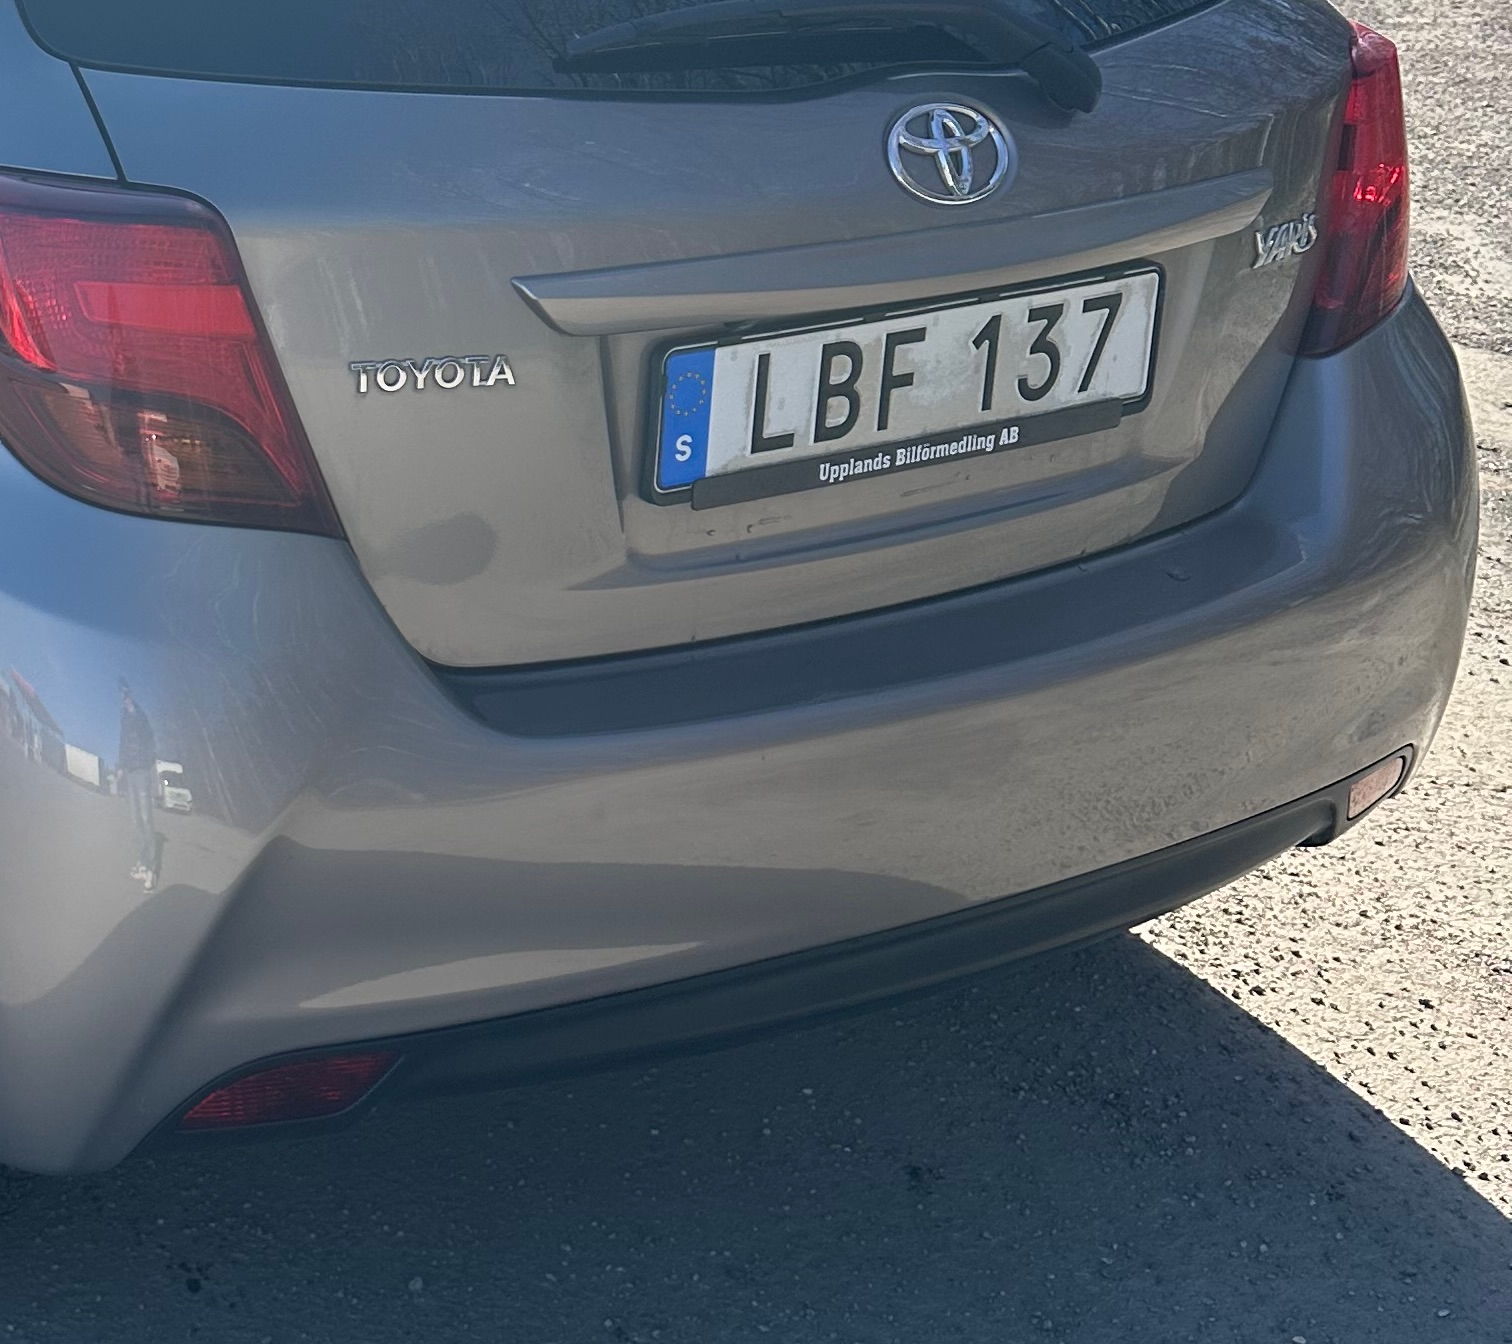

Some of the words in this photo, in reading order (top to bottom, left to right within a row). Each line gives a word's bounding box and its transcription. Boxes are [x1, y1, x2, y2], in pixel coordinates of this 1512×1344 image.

[350, 354, 516, 394] TOYOTA
[750, 326, 927, 455] LBF
[971, 292, 1124, 413] 137
[674, 434, 693, 462] S
[819, 452, 891, 483] Upplands
[895, 434, 995, 467] Bilförmedling
[999, 426, 1020, 446] AB
